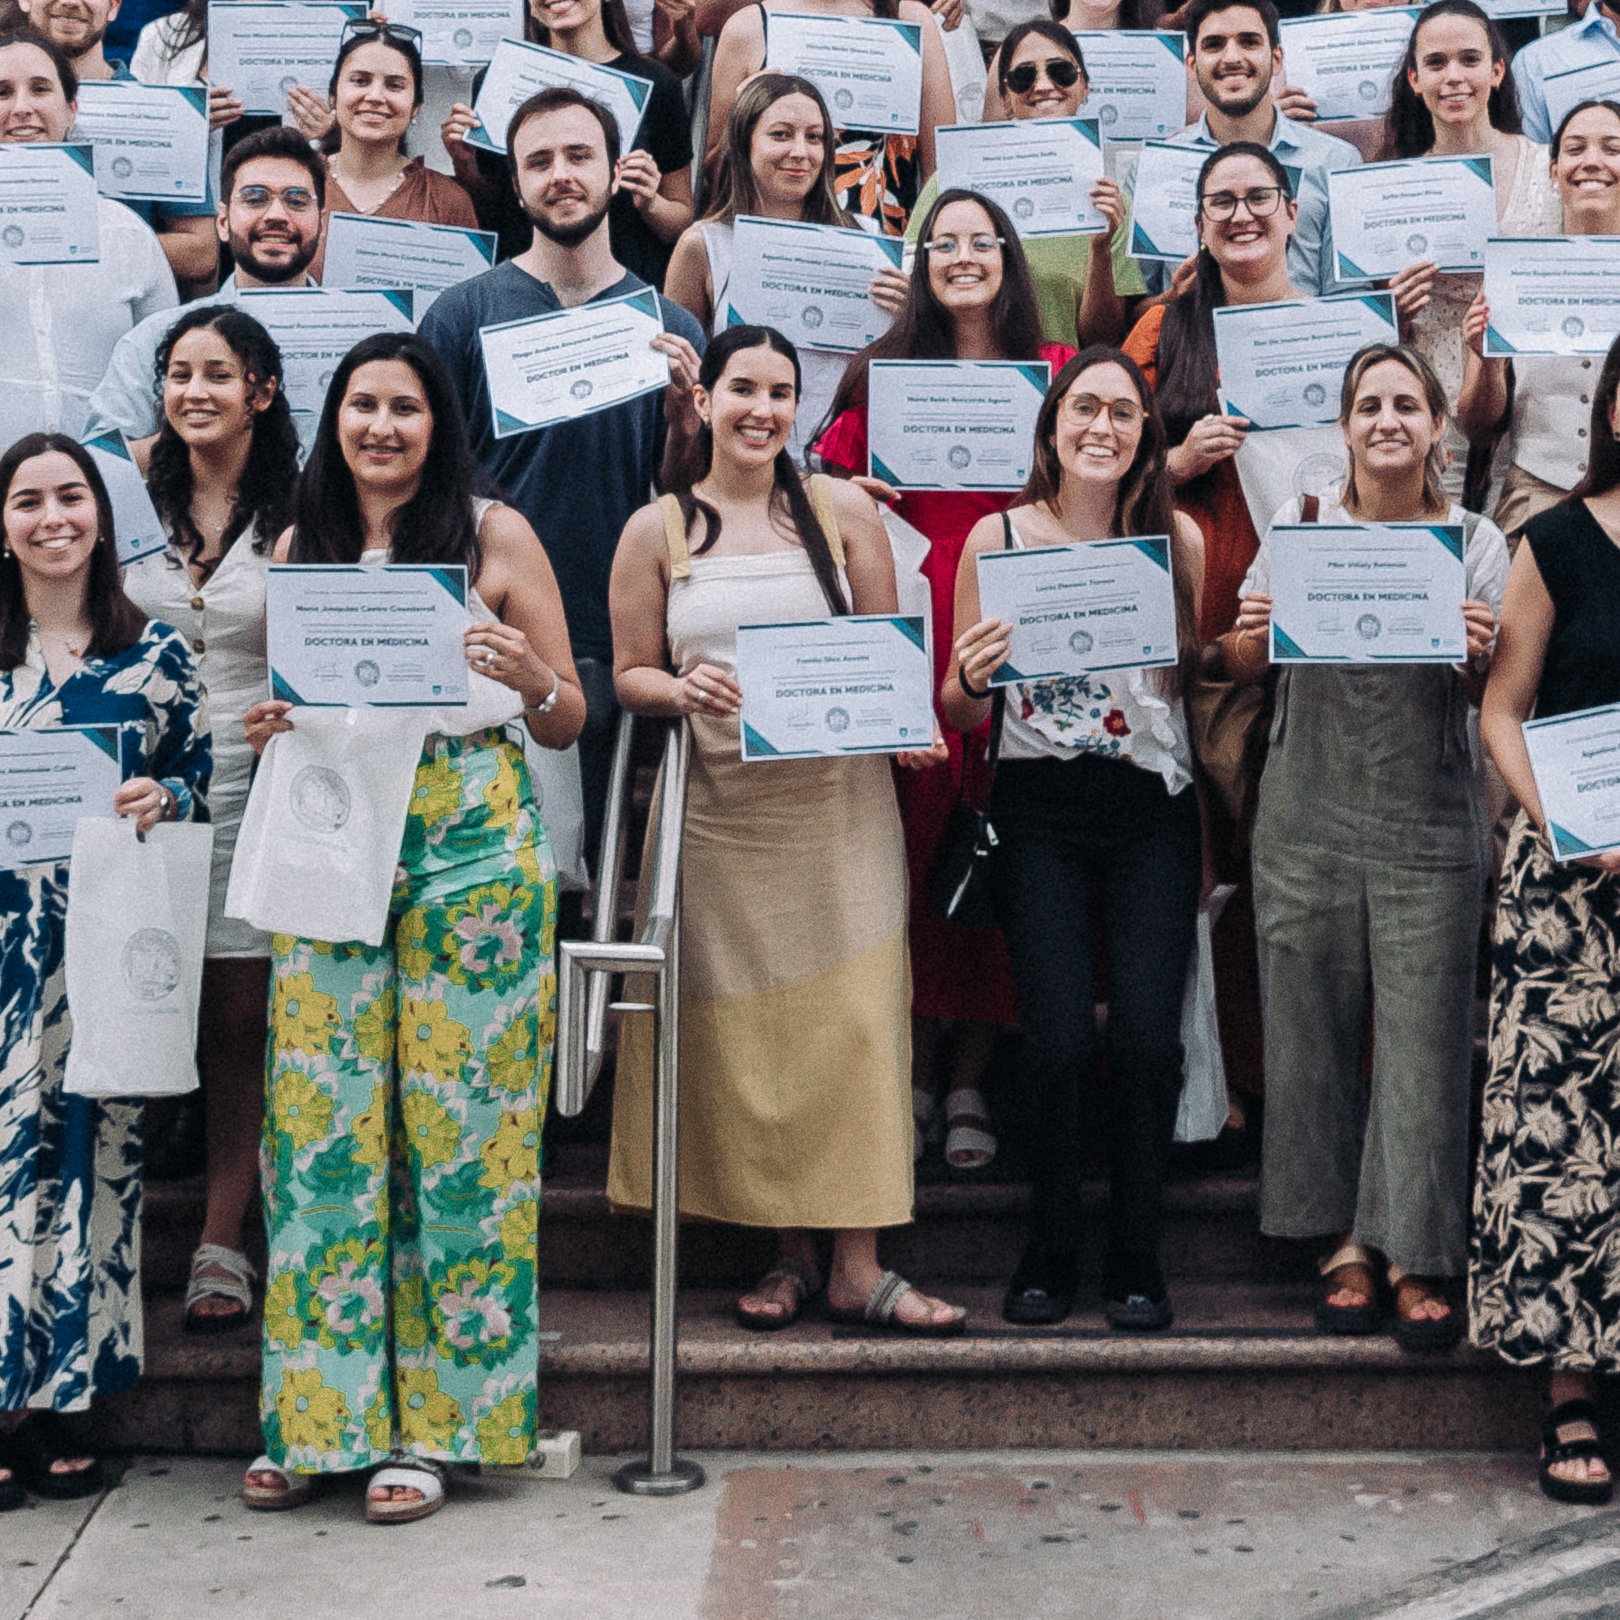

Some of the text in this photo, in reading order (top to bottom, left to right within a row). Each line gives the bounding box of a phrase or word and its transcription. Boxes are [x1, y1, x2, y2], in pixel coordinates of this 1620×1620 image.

[1029, 176, 1074, 187] MEDICINA
[20, 205, 66, 214] MEDICINA
[1410, 217, 1421, 226] EN
[1423, 213, 1467, 225] MEDICINA
[761, 281, 869, 301] DOCTORA EN MEDICINA
[1518, 297, 1566, 305] DOCTORA
[1568, 297, 1579, 305] EN
[525, 351, 631, 384] DOCTOR EN MEDICINA
[902, 424, 1016, 435] DOCTORA EN MEDICINA
[1307, 592, 1429, 602] DOCTORA EN MEDICINA
[1019, 604, 1139, 626] DOCTORA EN MEDICINA
[304, 637, 430, 648] DOCTORA EN MEDICINA
[775, 683, 894, 698] DOCTORA EN MEDICINA
[11, 798, 25, 808] EN
[28, 795, 83, 808] MEDICINA
